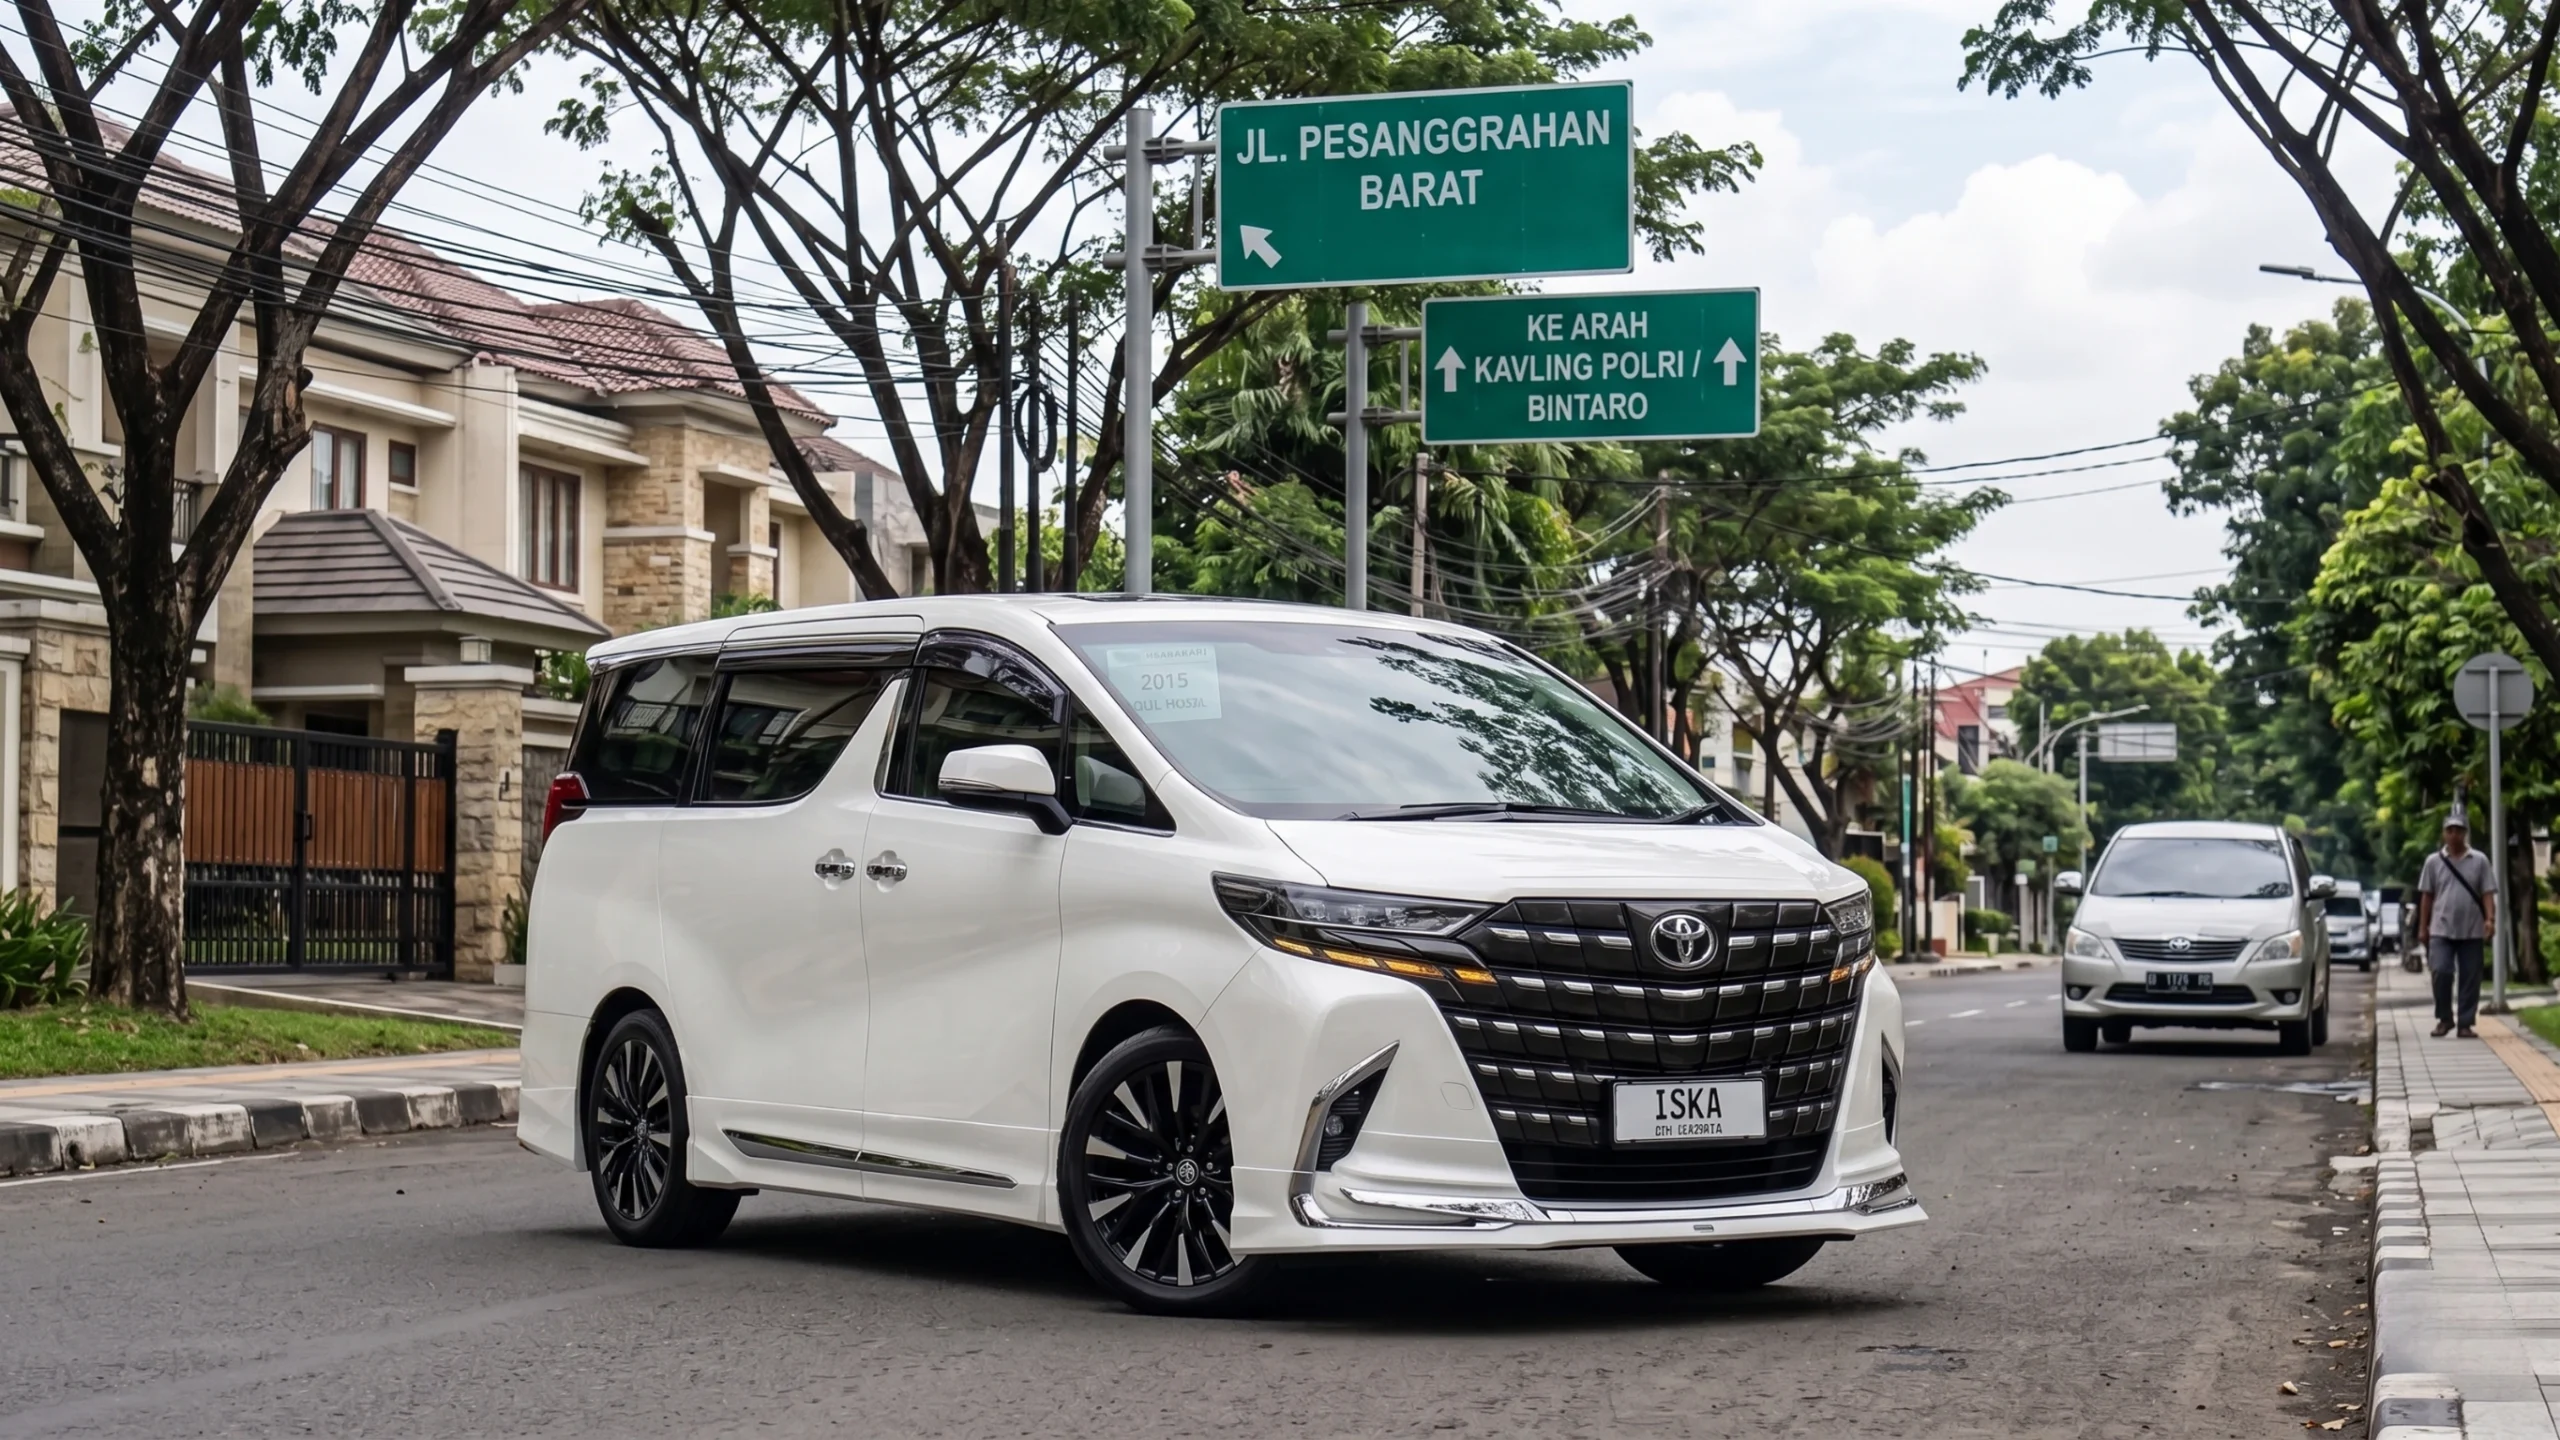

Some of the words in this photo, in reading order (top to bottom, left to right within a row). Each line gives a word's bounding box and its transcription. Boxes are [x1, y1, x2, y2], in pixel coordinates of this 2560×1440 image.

[1236, 128, 1287, 165] JL.
[1299, 108, 1611, 161] PESANGGRAHAN
[1360, 168, 1484, 211] BARAT
[1527, 314, 1564, 342] KE
[1570, 311, 1648, 340] ARAH
[1474, 352, 1593, 383] KAVLING
[1602, 350, 1685, 380] POLRI
[1692, 350, 1702, 378] /
[1527, 392, 1649, 422] BINTARO
[1141, 672, 1189, 691] 2015
[1655, 1087, 1723, 1121] ISKA
